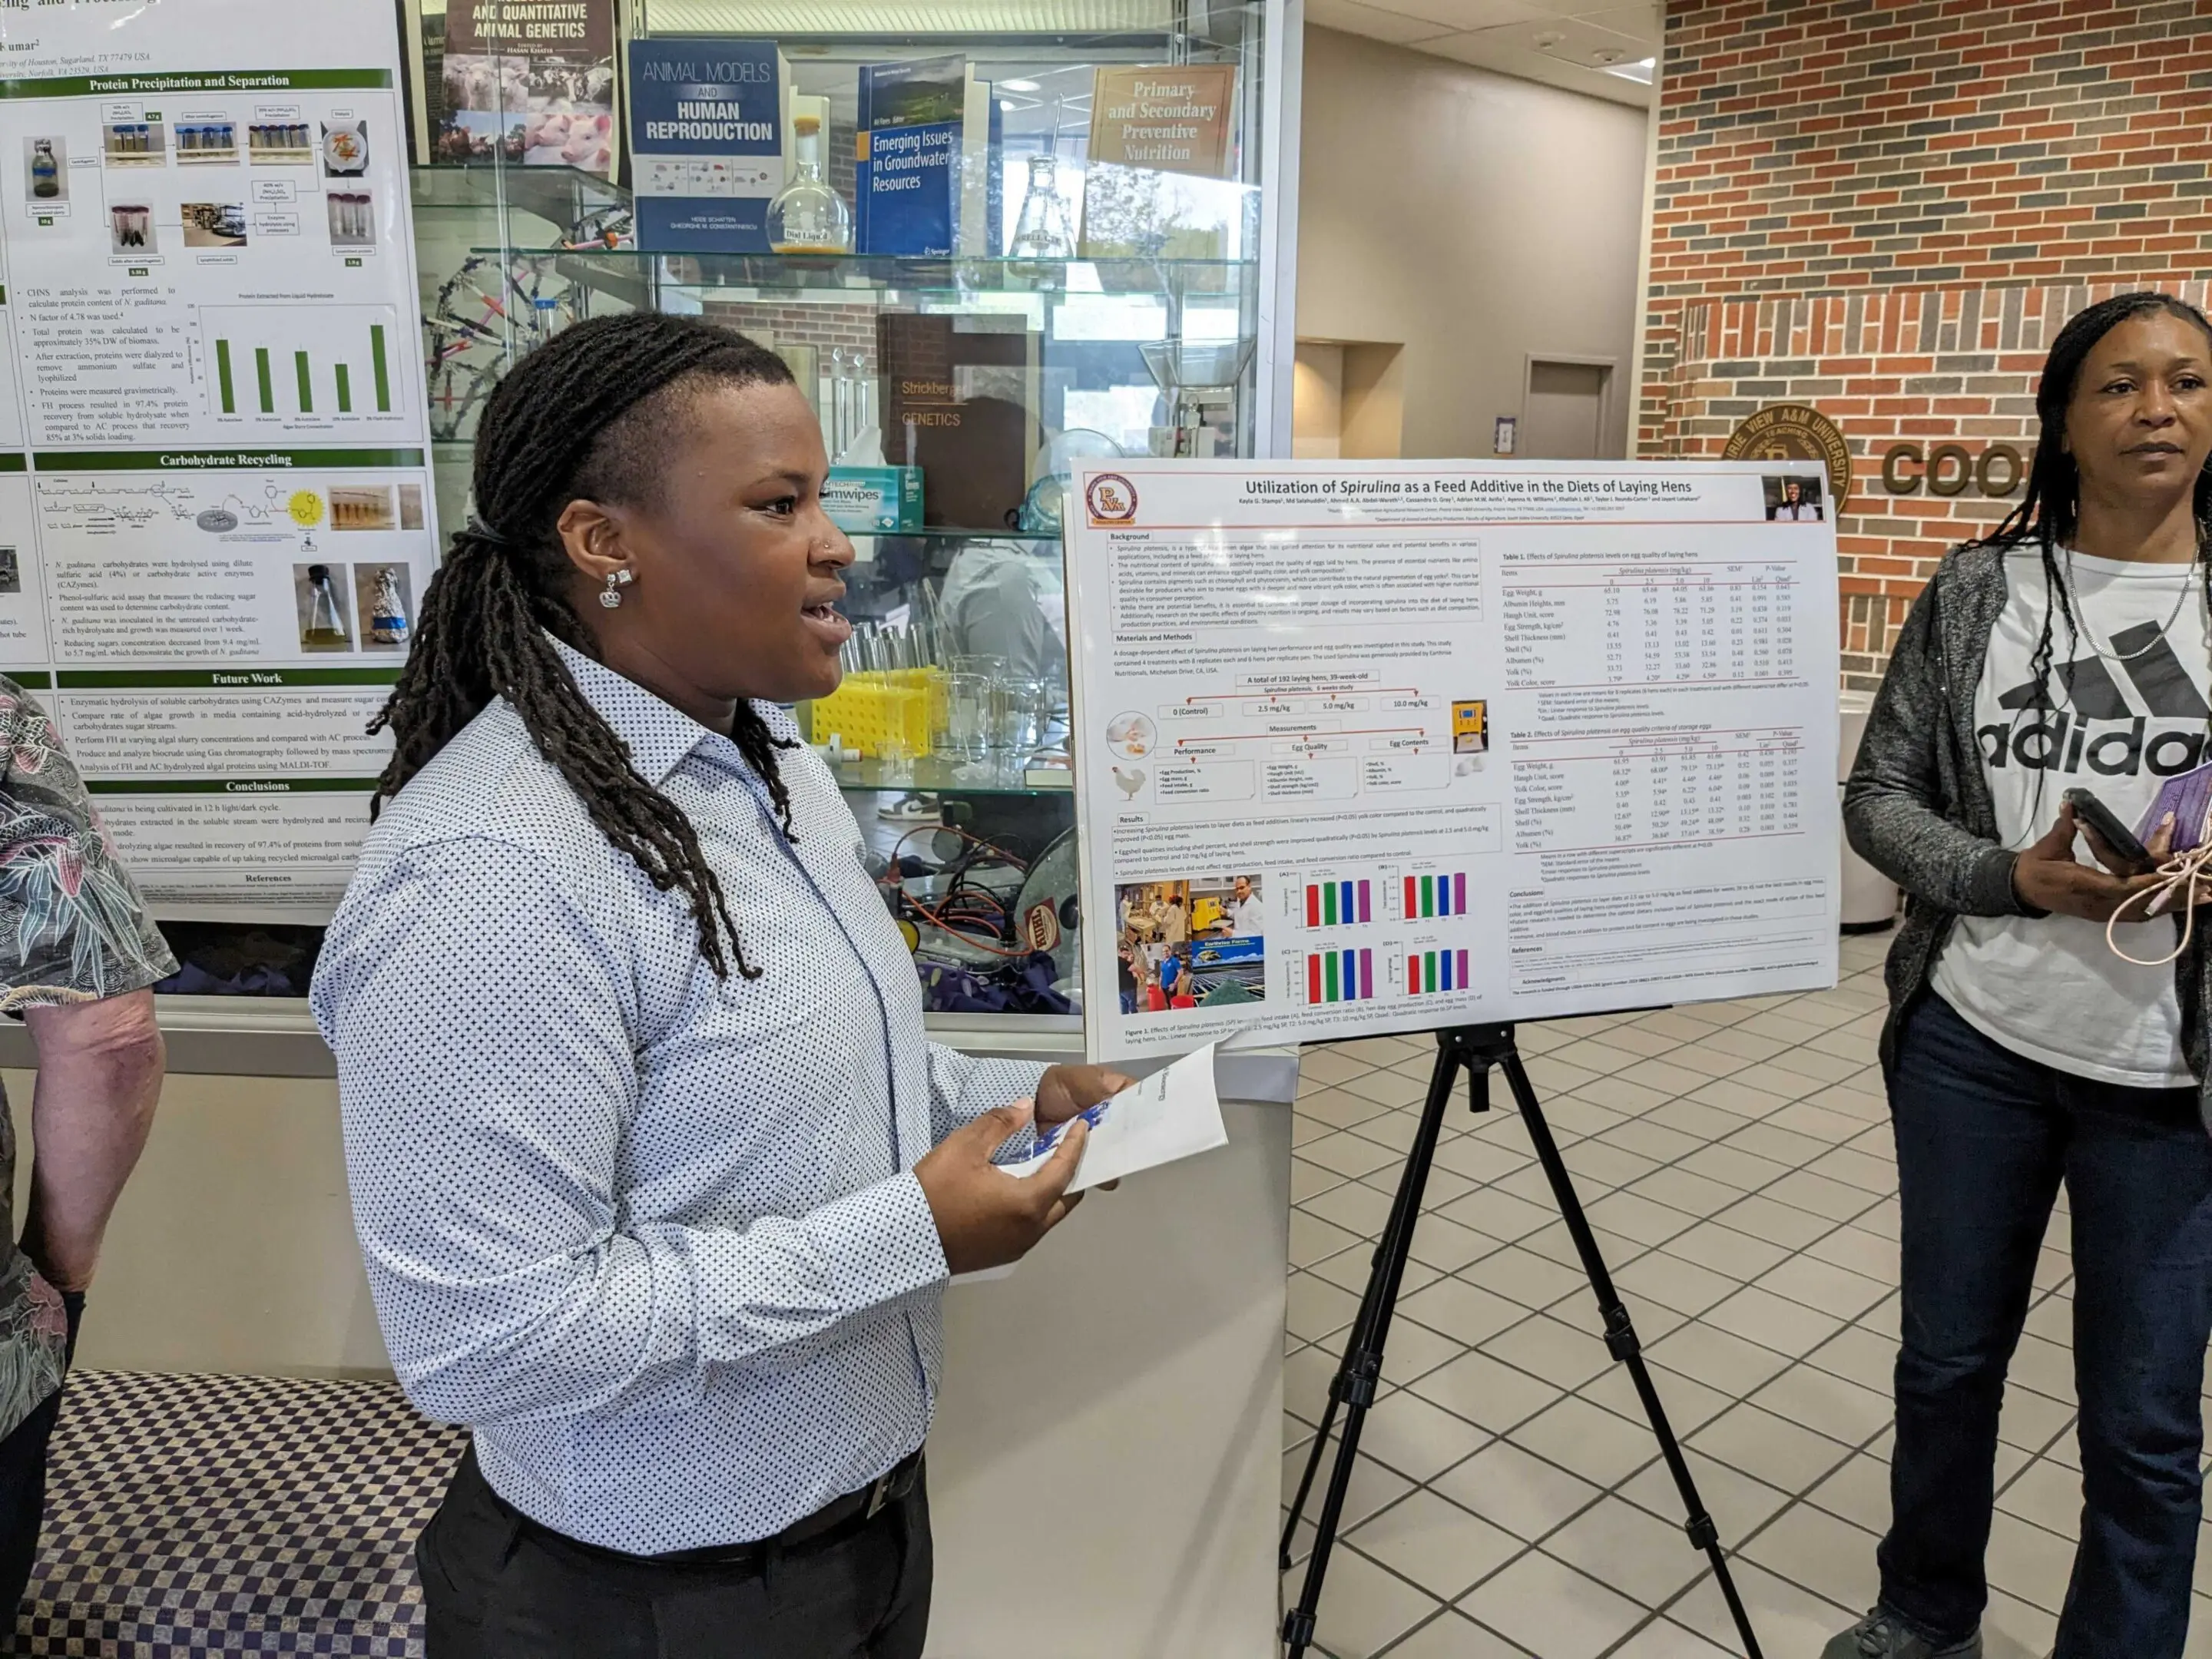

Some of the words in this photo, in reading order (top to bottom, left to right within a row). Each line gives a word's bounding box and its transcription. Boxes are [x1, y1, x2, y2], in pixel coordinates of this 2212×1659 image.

[472, 5, 496, 20] AND
[502, 4, 588, 20] QUANTITATIVE
[475, 24, 522, 38] ANIMAL
[525, 23, 585, 38] GENETICS
[643, 62, 701, 81] ANIMAL
[707, 62, 770, 82] MODELS
[90, 78, 128, 91] Protein
[131, 76, 202, 92] Precipitation
[204, 75, 224, 86] and
[228, 75, 289, 89] Separation
[1134, 81, 1195, 100] Primary
[698, 88, 717, 98] AND
[677, 102, 739, 120] HUMAN
[1109, 103, 1134, 118] and
[1140, 102, 1216, 121] Secondary
[647, 122, 773, 141] REPRODUCTION
[1122, 124, 1197, 139] Preventive
[874, 134, 920, 153] Emerging
[923, 131, 952, 146] Issues
[1124, 144, 1190, 161] Nutrition
[873, 158, 882, 172] in
[885, 152, 949, 171] Groundwater
[873, 176, 920, 192] Resources
[931, 247, 950, 256] Springer
[60, 288, 88, 298] analysis
[121, 287, 158, 298] performed
[28, 300, 58, 308] calculate
[61, 300, 86, 309] protein
[33, 327, 50, 336] Total
[58, 326, 82, 337] protein
[112, 326, 148, 334] calculated
[34, 338, 83, 347] approximately
[128, 336, 160, 345] biomass.
[902, 382, 966, 396] Strickberger
[902, 413, 961, 426] GENETICS
[1767, 427, 1808, 439] TEACHING
[1727, 433, 1747, 458] IRIE
[1746, 412, 1773, 433] VIEW
[1781, 408, 1810, 424] A&M
[1813, 417, 1846, 487] UNIVERSITY
[160, 455, 237, 467] Carbohydrate
[238, 453, 292, 467] Recycling
[1882, 444, 2035, 496] COO
[1246, 480, 1318, 494] Utilization
[1322, 480, 1336, 493] of
[1339, 479, 1401, 495] Spirulina
[1404, 482, 1419, 493] as
[1422, 484, 1430, 492] a
[1435, 479, 1465, 492] Feed
[1470, 480, 1523, 492] Additive
[1527, 480, 1539, 492] in
[1542, 480, 1564, 492] the
[1568, 480, 1599, 492] Diets
[1603, 480, 1615, 492] of
[1619, 481, 1657, 495] Laying
[1661, 481, 1692, 492] Hens
[828, 488, 879, 502] imwipes
[212, 674, 249, 684] Future
[251, 673, 283, 684] Work
[1291, 674, 1310, 683] laying
[1270, 705, 1290, 714] mg/kg
[1334, 702, 1354, 710] mg/kg
[1408, 700, 1428, 708] mg/kg
[1179, 707, 1208, 717] (Control)
[74, 724, 124, 732] carbohydrates
[1977, 711, 2212, 776] adida
[80, 763, 110, 772] Analysis
[163, 762, 205, 772] hydrolyzed
[207, 761, 225, 771] algal
[227, 761, 256, 771] proteins
[258, 761, 278, 770] using
[226, 781, 290, 791] Conclusions
[246, 874, 292, 882] References
